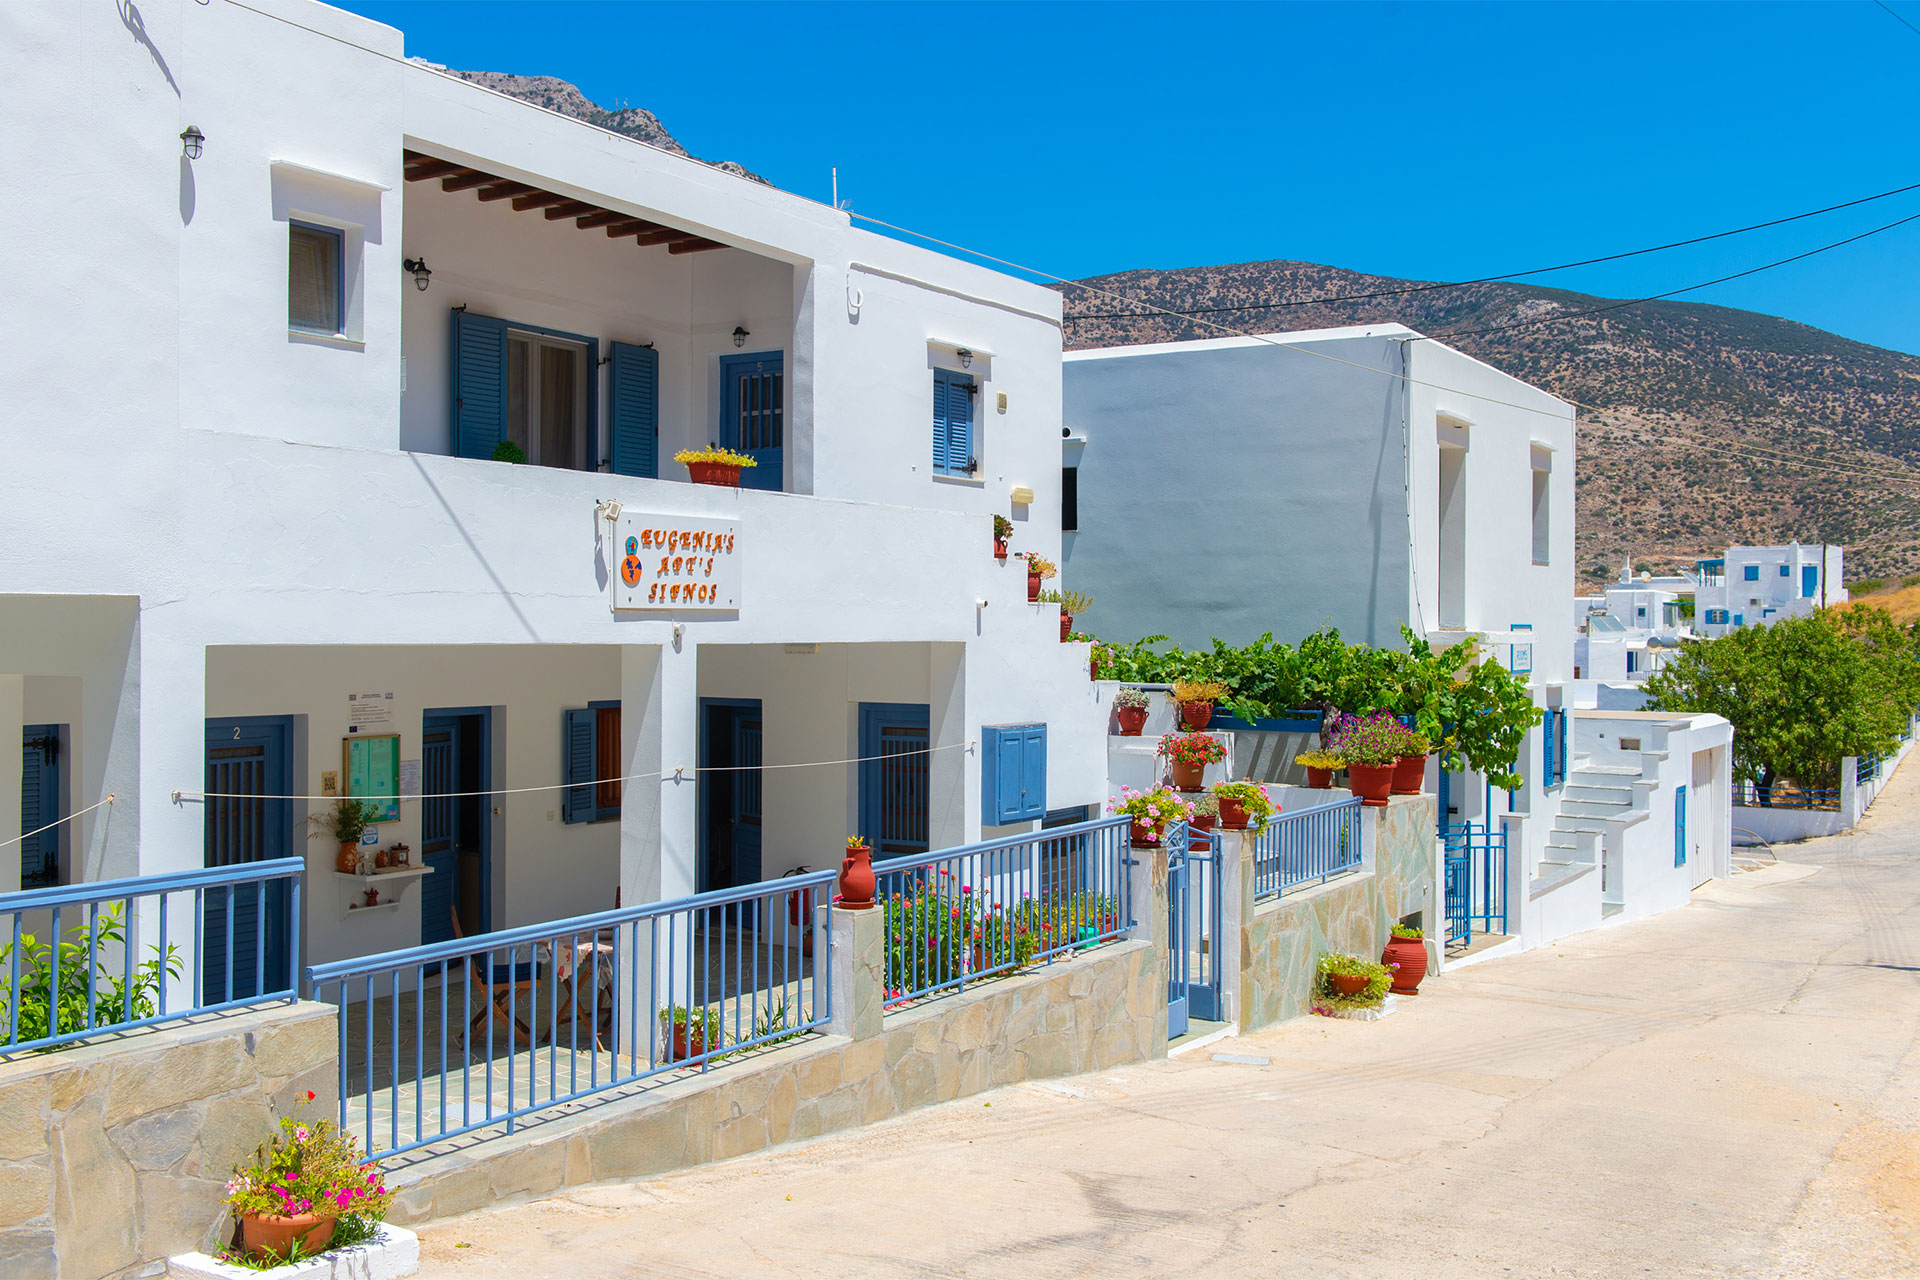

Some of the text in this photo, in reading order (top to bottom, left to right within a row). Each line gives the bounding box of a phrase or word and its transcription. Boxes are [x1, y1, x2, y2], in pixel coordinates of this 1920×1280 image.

[641, 529, 734, 551] EUGENIA'S
[657, 556, 713, 573] APT'S
[648, 583, 717, 600] SIFNOS
[233, 726, 240, 740] 2
